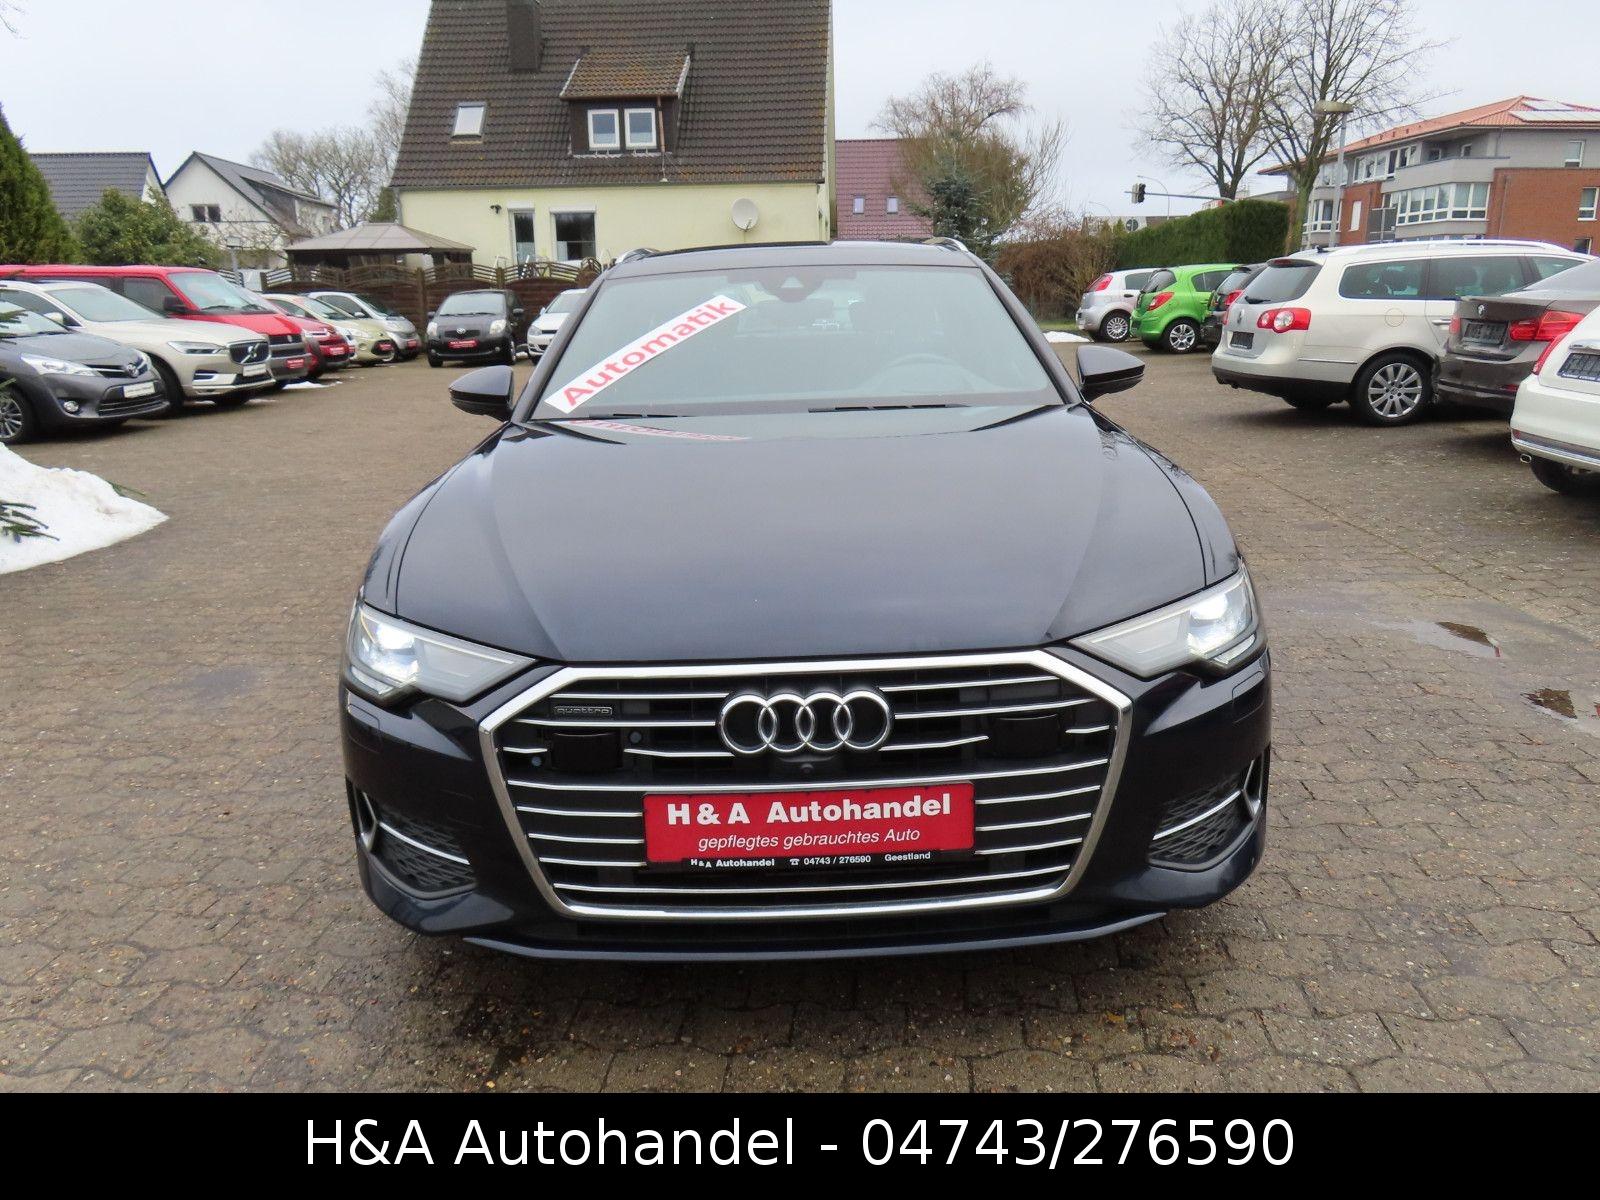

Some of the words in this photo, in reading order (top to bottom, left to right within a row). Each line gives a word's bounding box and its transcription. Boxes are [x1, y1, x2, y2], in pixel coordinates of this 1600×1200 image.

[563, 301, 737, 406] Automatik
[766, 793, 951, 824] Autohandel
[698, 833, 779, 852] gepflegtes
[783, 830, 880, 849] gebrauchtes
[884, 828, 921, 842] Auto
[715, 858, 775, 868] Autohandel
[803, 856, 832, 865] 04743
[838, 855, 872, 864] 276590
[884, 851, 931, 862] Geestland
